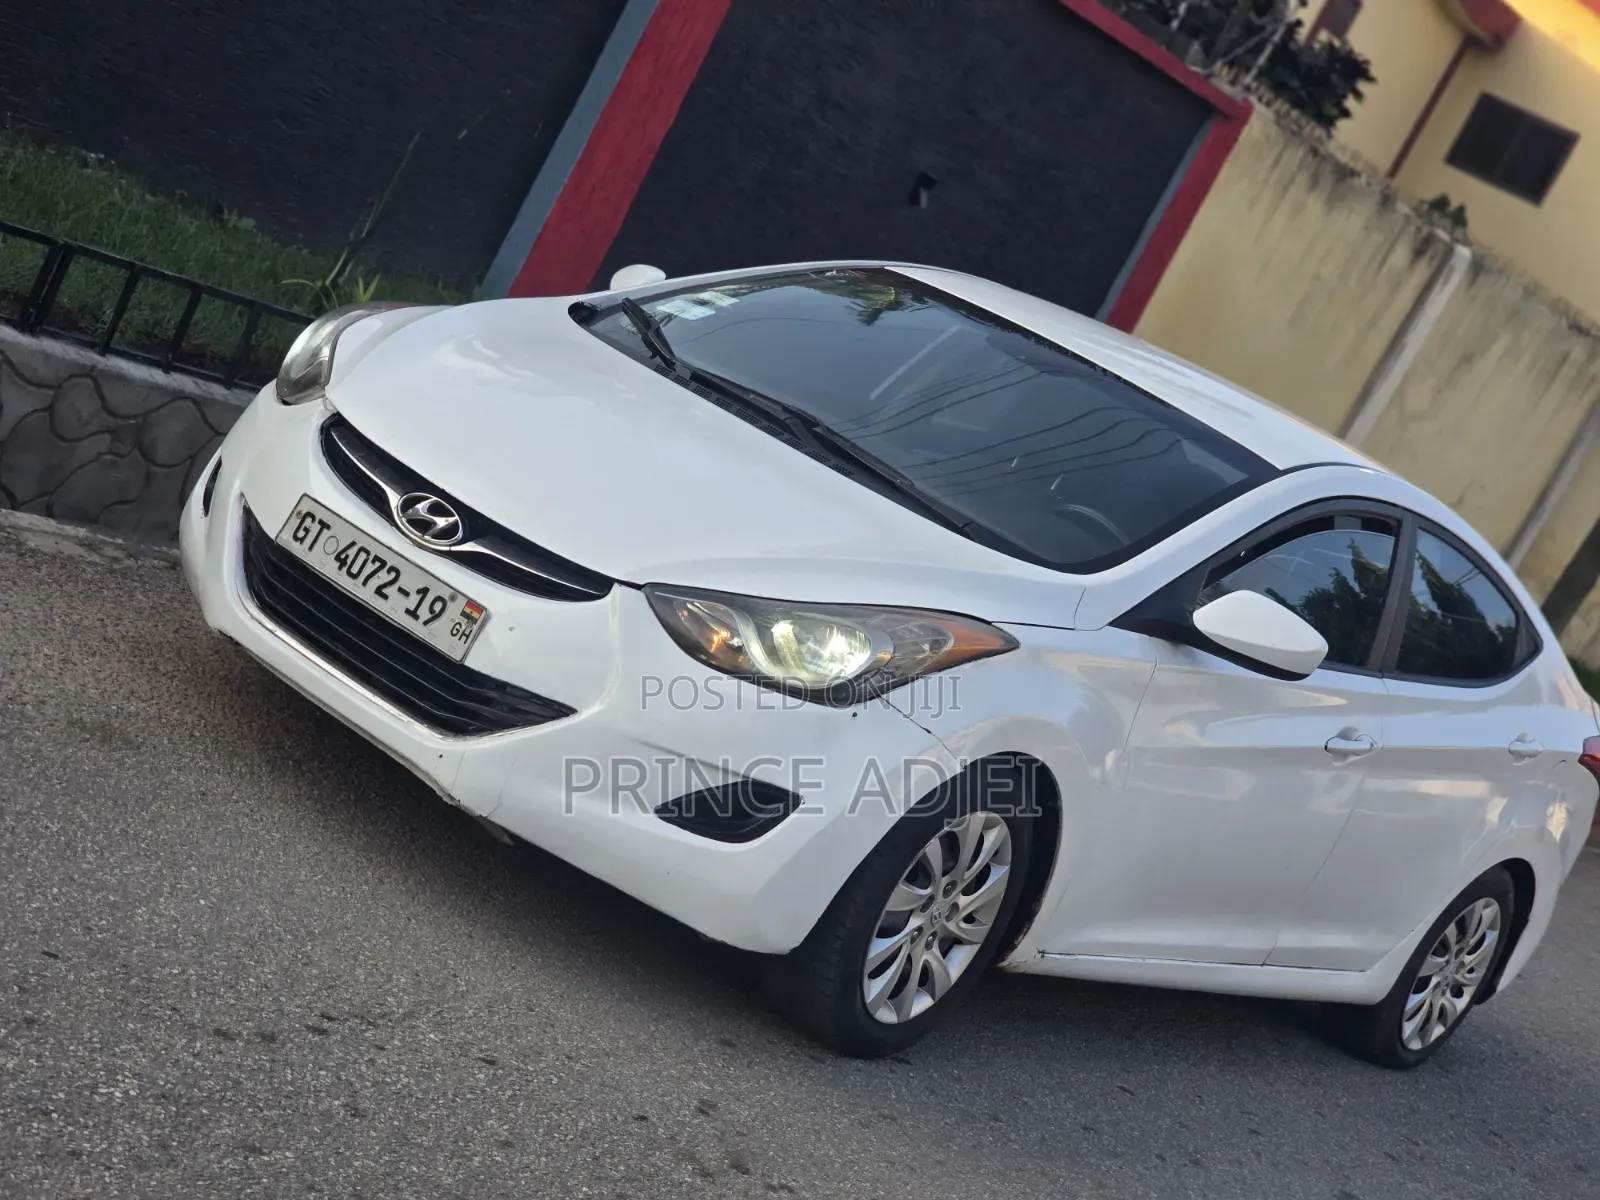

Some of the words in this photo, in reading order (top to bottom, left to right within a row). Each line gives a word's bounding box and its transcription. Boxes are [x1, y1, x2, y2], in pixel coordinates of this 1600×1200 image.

[292, 511, 331, 552] GT
[334, 540, 448, 626] 4072-19
[450, 621, 473, 645] GH
